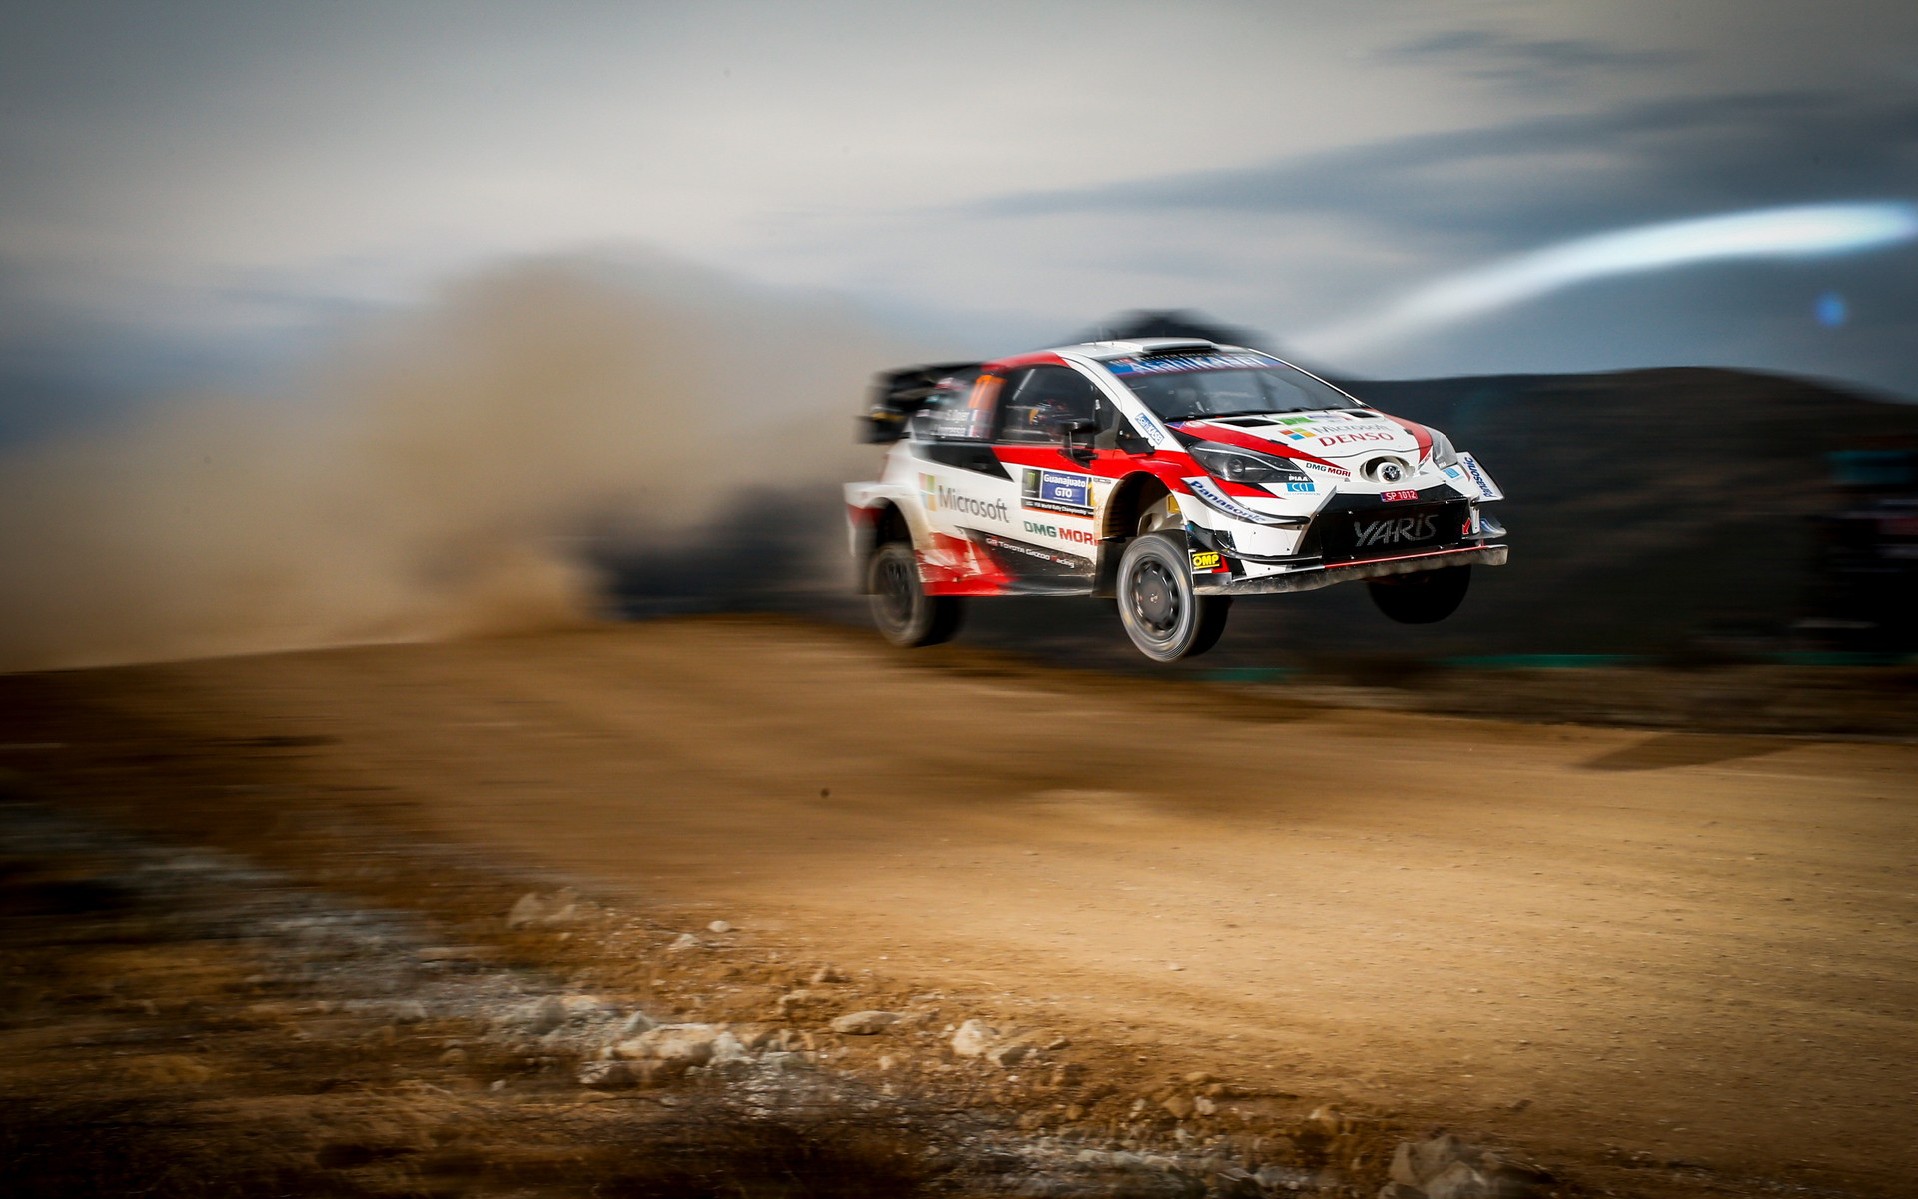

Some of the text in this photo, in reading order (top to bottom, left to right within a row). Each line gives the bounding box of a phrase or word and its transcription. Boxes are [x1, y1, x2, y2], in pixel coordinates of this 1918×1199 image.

[1311, 423, 1394, 434] Microsoft
[1319, 432, 1394, 447] DENSO
[1306, 462, 1351, 477] DMG MORI
[1464, 456, 1497, 498] Panasonic
[1044, 474, 1086, 488] Guanajuato
[1055, 487, 1073, 498] GTO
[1386, 490, 1416, 501] SP 1012
[939, 485, 1010, 523] Microsoft
[1190, 480, 1266, 522] Panasonic
[1024, 520, 1057, 538] DMG
[1193, 554, 1219, 567] OMP
